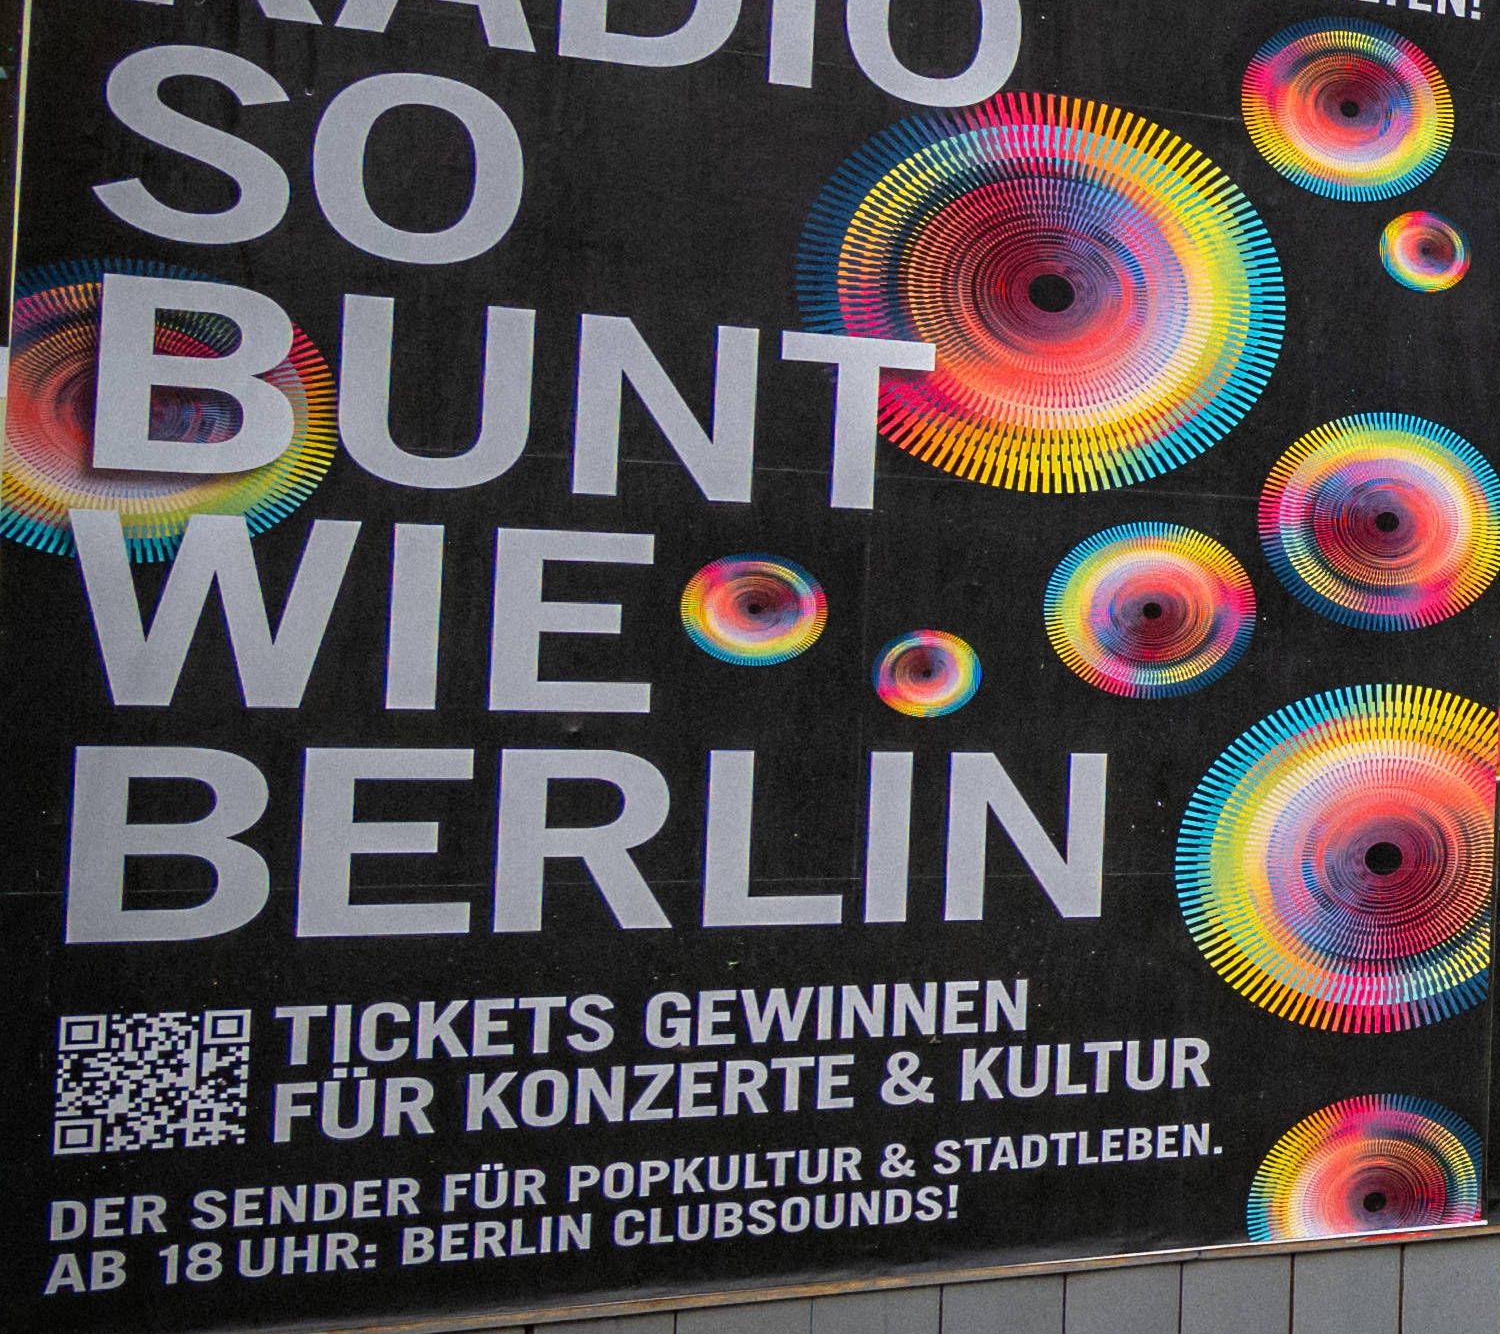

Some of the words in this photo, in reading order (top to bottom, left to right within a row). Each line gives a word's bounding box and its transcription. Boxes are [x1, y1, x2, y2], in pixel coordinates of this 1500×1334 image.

[94, 45, 525, 265] SO
[93, 271, 937, 510] BUNT
[71, 507, 655, 715] WIE
[62, 742, 1109, 945] BERLIN
[270, 1067, 434, 1145] FÜR
[465, 1052, 855, 1133] KONZERTE
[881, 1051, 935, 1107] &
[960, 1036, 1212, 1102] KULTUR
[272, 991, 615, 1067] TICKETS
[645, 977, 1030, 1049] GEWINNEN
[45, 1248, 129, 1296] AB
[158, 1241, 222, 1286] 18
[239, 1228, 378, 1278] UHR:
[400, 1212, 592, 1268] BERLIN
[612, 1185, 960, 1247] CLUBSOUNDS!
[48, 1193, 165, 1243] DER
[190, 1178, 421, 1232] SENDER
[442, 1157, 550, 1213] FÜR
[569, 1146, 865, 1205] POPKULTUR
[881, 1142, 915, 1177] &
[932, 1123, 1224, 1173] STADTLEBEN.
